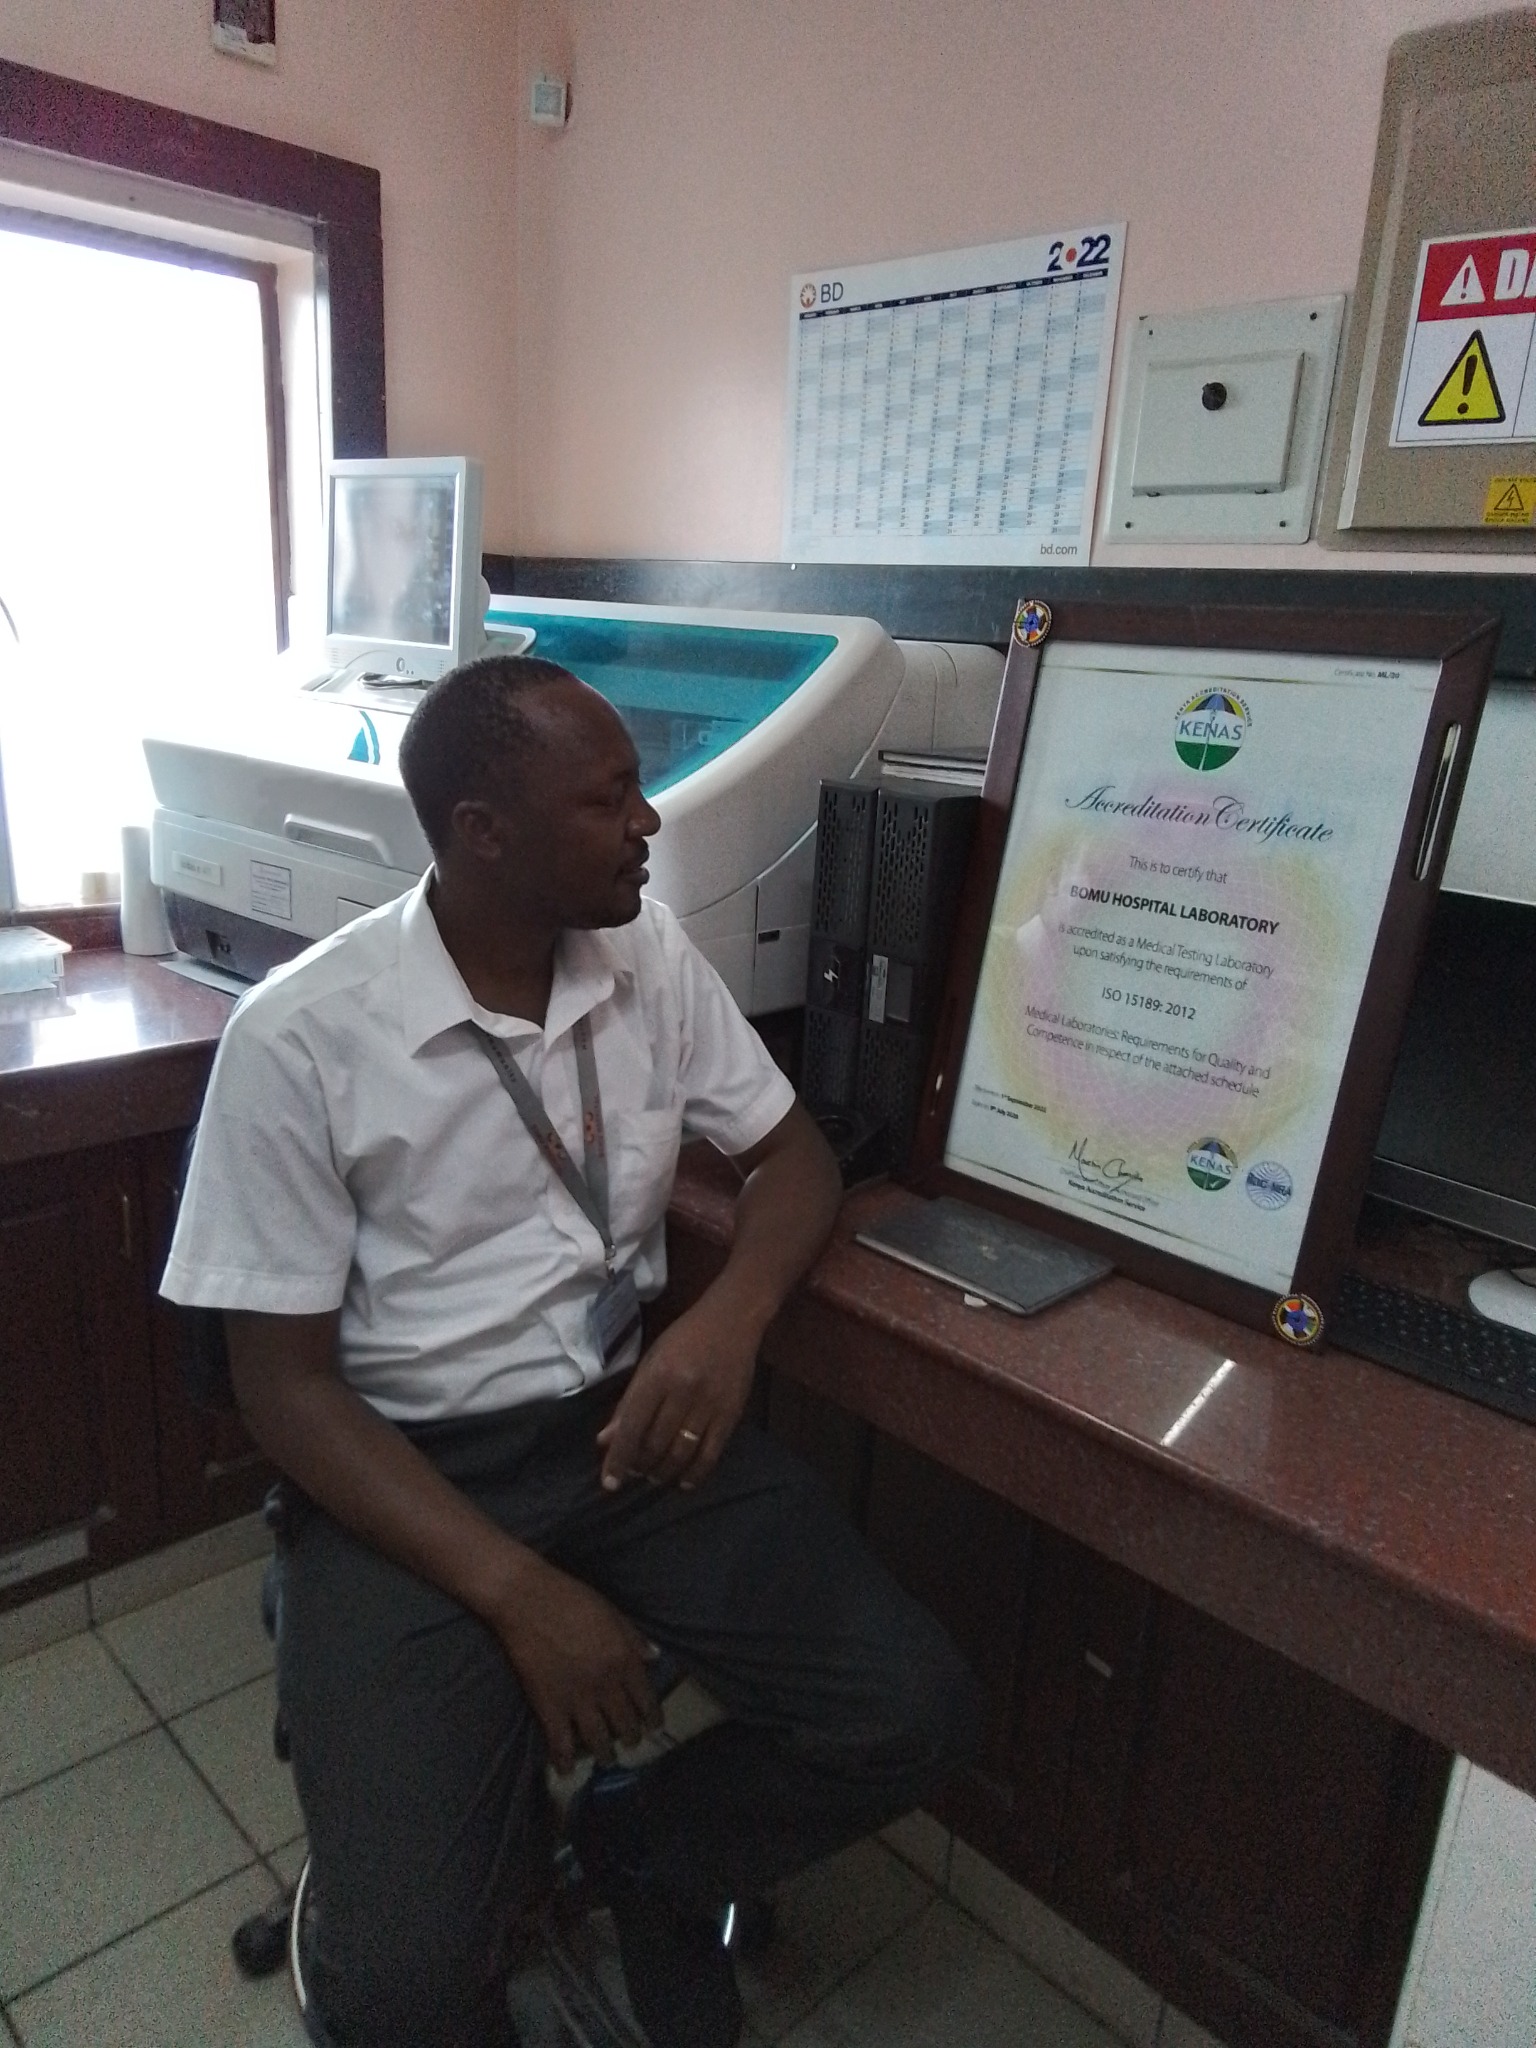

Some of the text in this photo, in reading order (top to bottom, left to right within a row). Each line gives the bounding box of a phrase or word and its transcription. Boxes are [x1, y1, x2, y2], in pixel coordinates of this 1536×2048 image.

[820, 281, 844, 303] BD
[1039, 543, 1078, 555] bd.com
[1178, 719, 1244, 741] KENAS
[1064, 785, 1334, 844] Accreditation Certificate
[1129, 855, 1228, 885] This is to certify that
[1069, 884, 1280, 936] BOMU HOSPITAL LABORATORY
[1066, 923, 1115, 944] accredited
[1116, 935, 1127, 947] as
[1128, 938, 1134, 948] a
[1136, 936, 1176, 957] Medical
[1177, 943, 1213, 967] Testing
[1215, 953, 1275, 979] Laboratory
[1073, 943, 1249, 991] upon satisfying the requirements of
[1101, 985, 1197, 1021] ISO 15189: 2012
[1024, 1004, 1060, 1024] Medical
[1120, 1029, 1190, 1059] Requirements
[1190, 1047, 1207, 1062] for
[1207, 1052, 1248, 1076] Quality
[1247, 1064, 1273, 1080] and
[1026, 1023, 1084, 1050] Competence
[1095, 1044, 1132, 1062] respect
[1132, 1053, 1144, 1065] of
[1144, 1056, 1162, 1071] the
[1162, 1062, 1210, 1084] attached
[1210, 1074, 1261, 1099] schedule
[1189, 1154, 1233, 1176] KENAS
